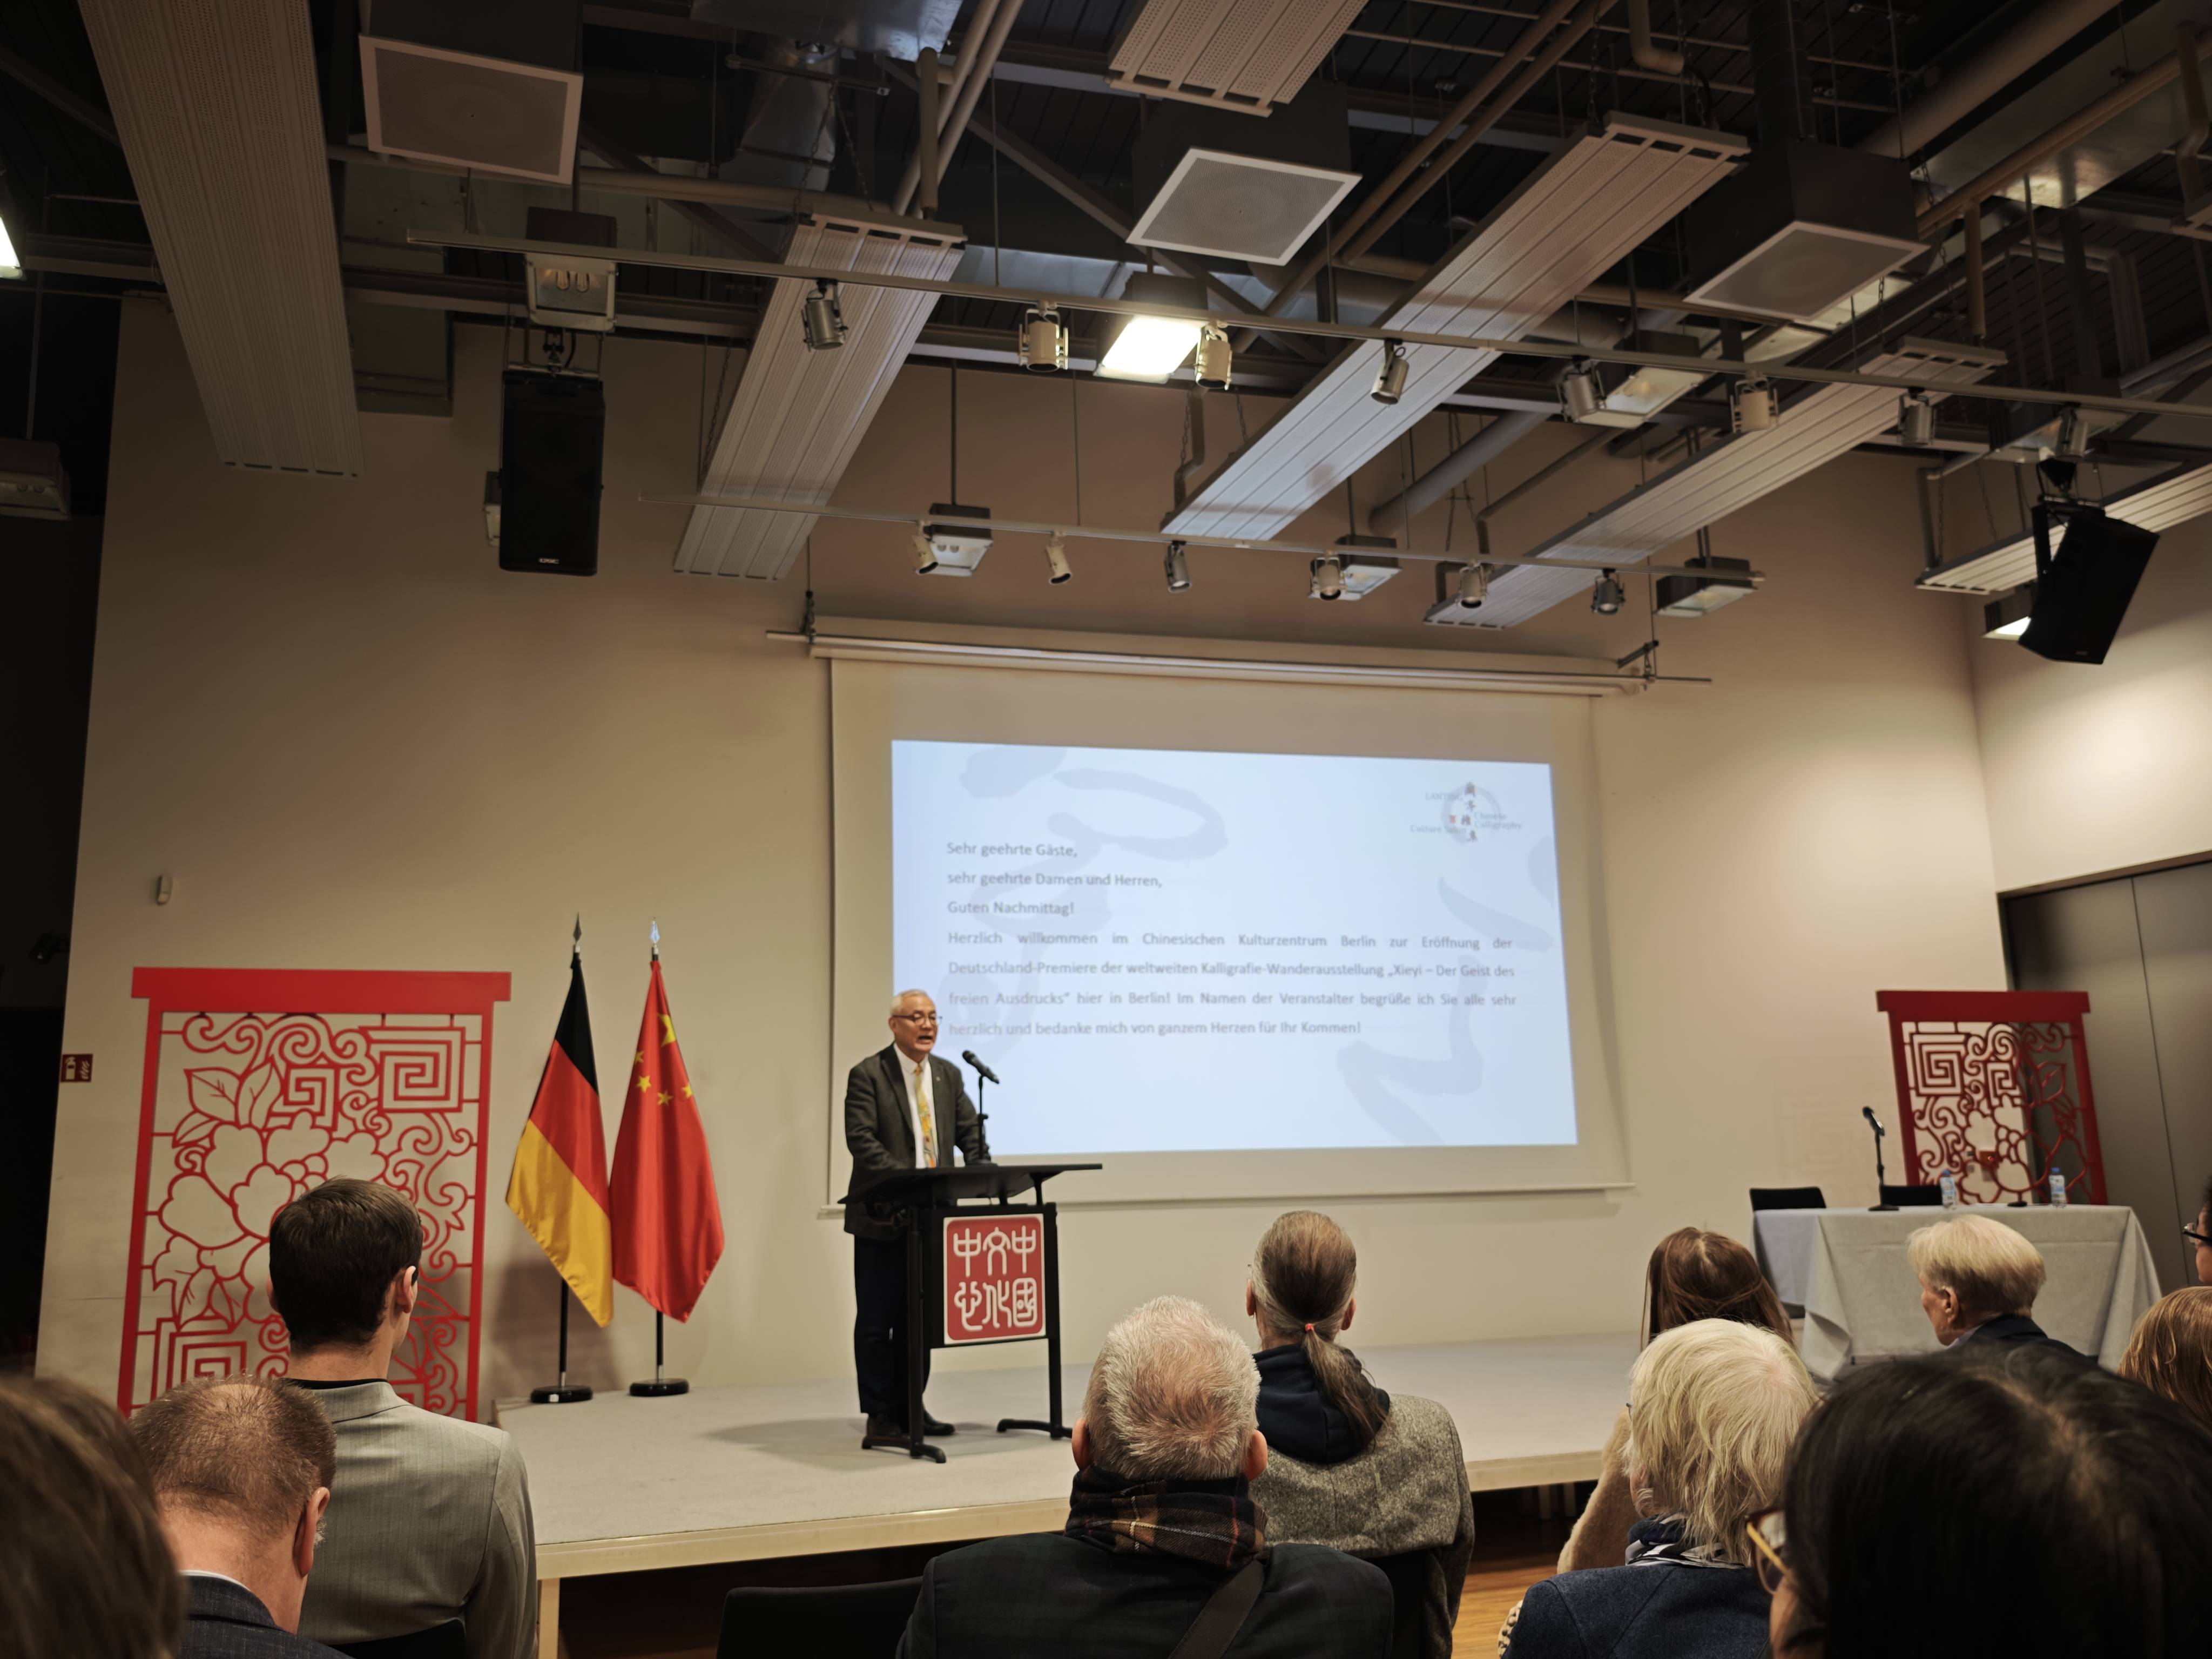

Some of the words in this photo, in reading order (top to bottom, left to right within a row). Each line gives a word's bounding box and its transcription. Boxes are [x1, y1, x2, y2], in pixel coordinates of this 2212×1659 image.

[947, 843, 976, 854] Sehr
[981, 844, 1032, 857] geehrte
[1036, 845, 1077, 858] Gäste,
[948, 873, 976, 884] sehr
[981, 874, 1032, 887] geehrte
[1036, 874, 1083, 885] Damen
[1087, 874, 1111, 886] und
[1115, 875, 1162, 888] Herren,
[948, 903, 989, 914] Guten
[994, 903, 1074, 916] Nachmittag!
[949, 933, 1002, 943] Herzlich
[1018, 933, 1097, 944] willkommen
[1112, 934, 1128, 944] im
[1143, 934, 1225, 945] Chinesischen
[1239, 935, 1327, 947] Kulturzentrum
[1341, 936, 1376, 947] Berlin
[1390, 938, 1407, 947] zur
[1422, 936, 1480, 950] Eröffnung
[1493, 938, 1512, 948] der
[949, 962, 1097, 973] Deutschland-Premiere
[1101, 963, 1122, 973] der
[1126, 963, 1197, 973] weltweiten
[1202, 963, 1384, 977] Kalligrafie-Wanderausstellung
[1437, 966, 1456, 976] Der
[1461, 966, 1491, 976] Geist
[1494, 966, 1514, 976] des
[949, 993, 988, 1004] freien
[1077, 993, 1102, 1003] hier
[1110, 993, 1122, 1003] in
[1129, 993, 1170, 1003] Berlin!
[1177, 993, 1193, 1003] Im
[1201, 993, 1246, 1003] Namen
[1252, 994, 1272, 1004] der
[1280, 994, 1354, 1004] Veranstalter
[1361, 994, 1411, 1007] begrüße
[1418, 994, 1434, 1005] ich
[1441, 995, 1458, 1005] Sie
[1464, 995, 1485, 1006] alle
[1492, 995, 1516, 1006] sehr
[949, 1023, 1002, 1035] herzlich
[1006, 1023, 1031, 1034] und
[1036, 1023, 1092, 1034] bedanke
[1096, 1023, 1128, 1034] mich
[1132, 1024, 1154, 1034] von
[1158, 1024, 1207, 1036] ganzem
[1211, 1023, 1255, 1033] Herzen
[1259, 1022, 1276, 1033] für
[1280, 1022, 1297, 1033] Ihr
[1301, 1022, 1361, 1033] Kommen!
